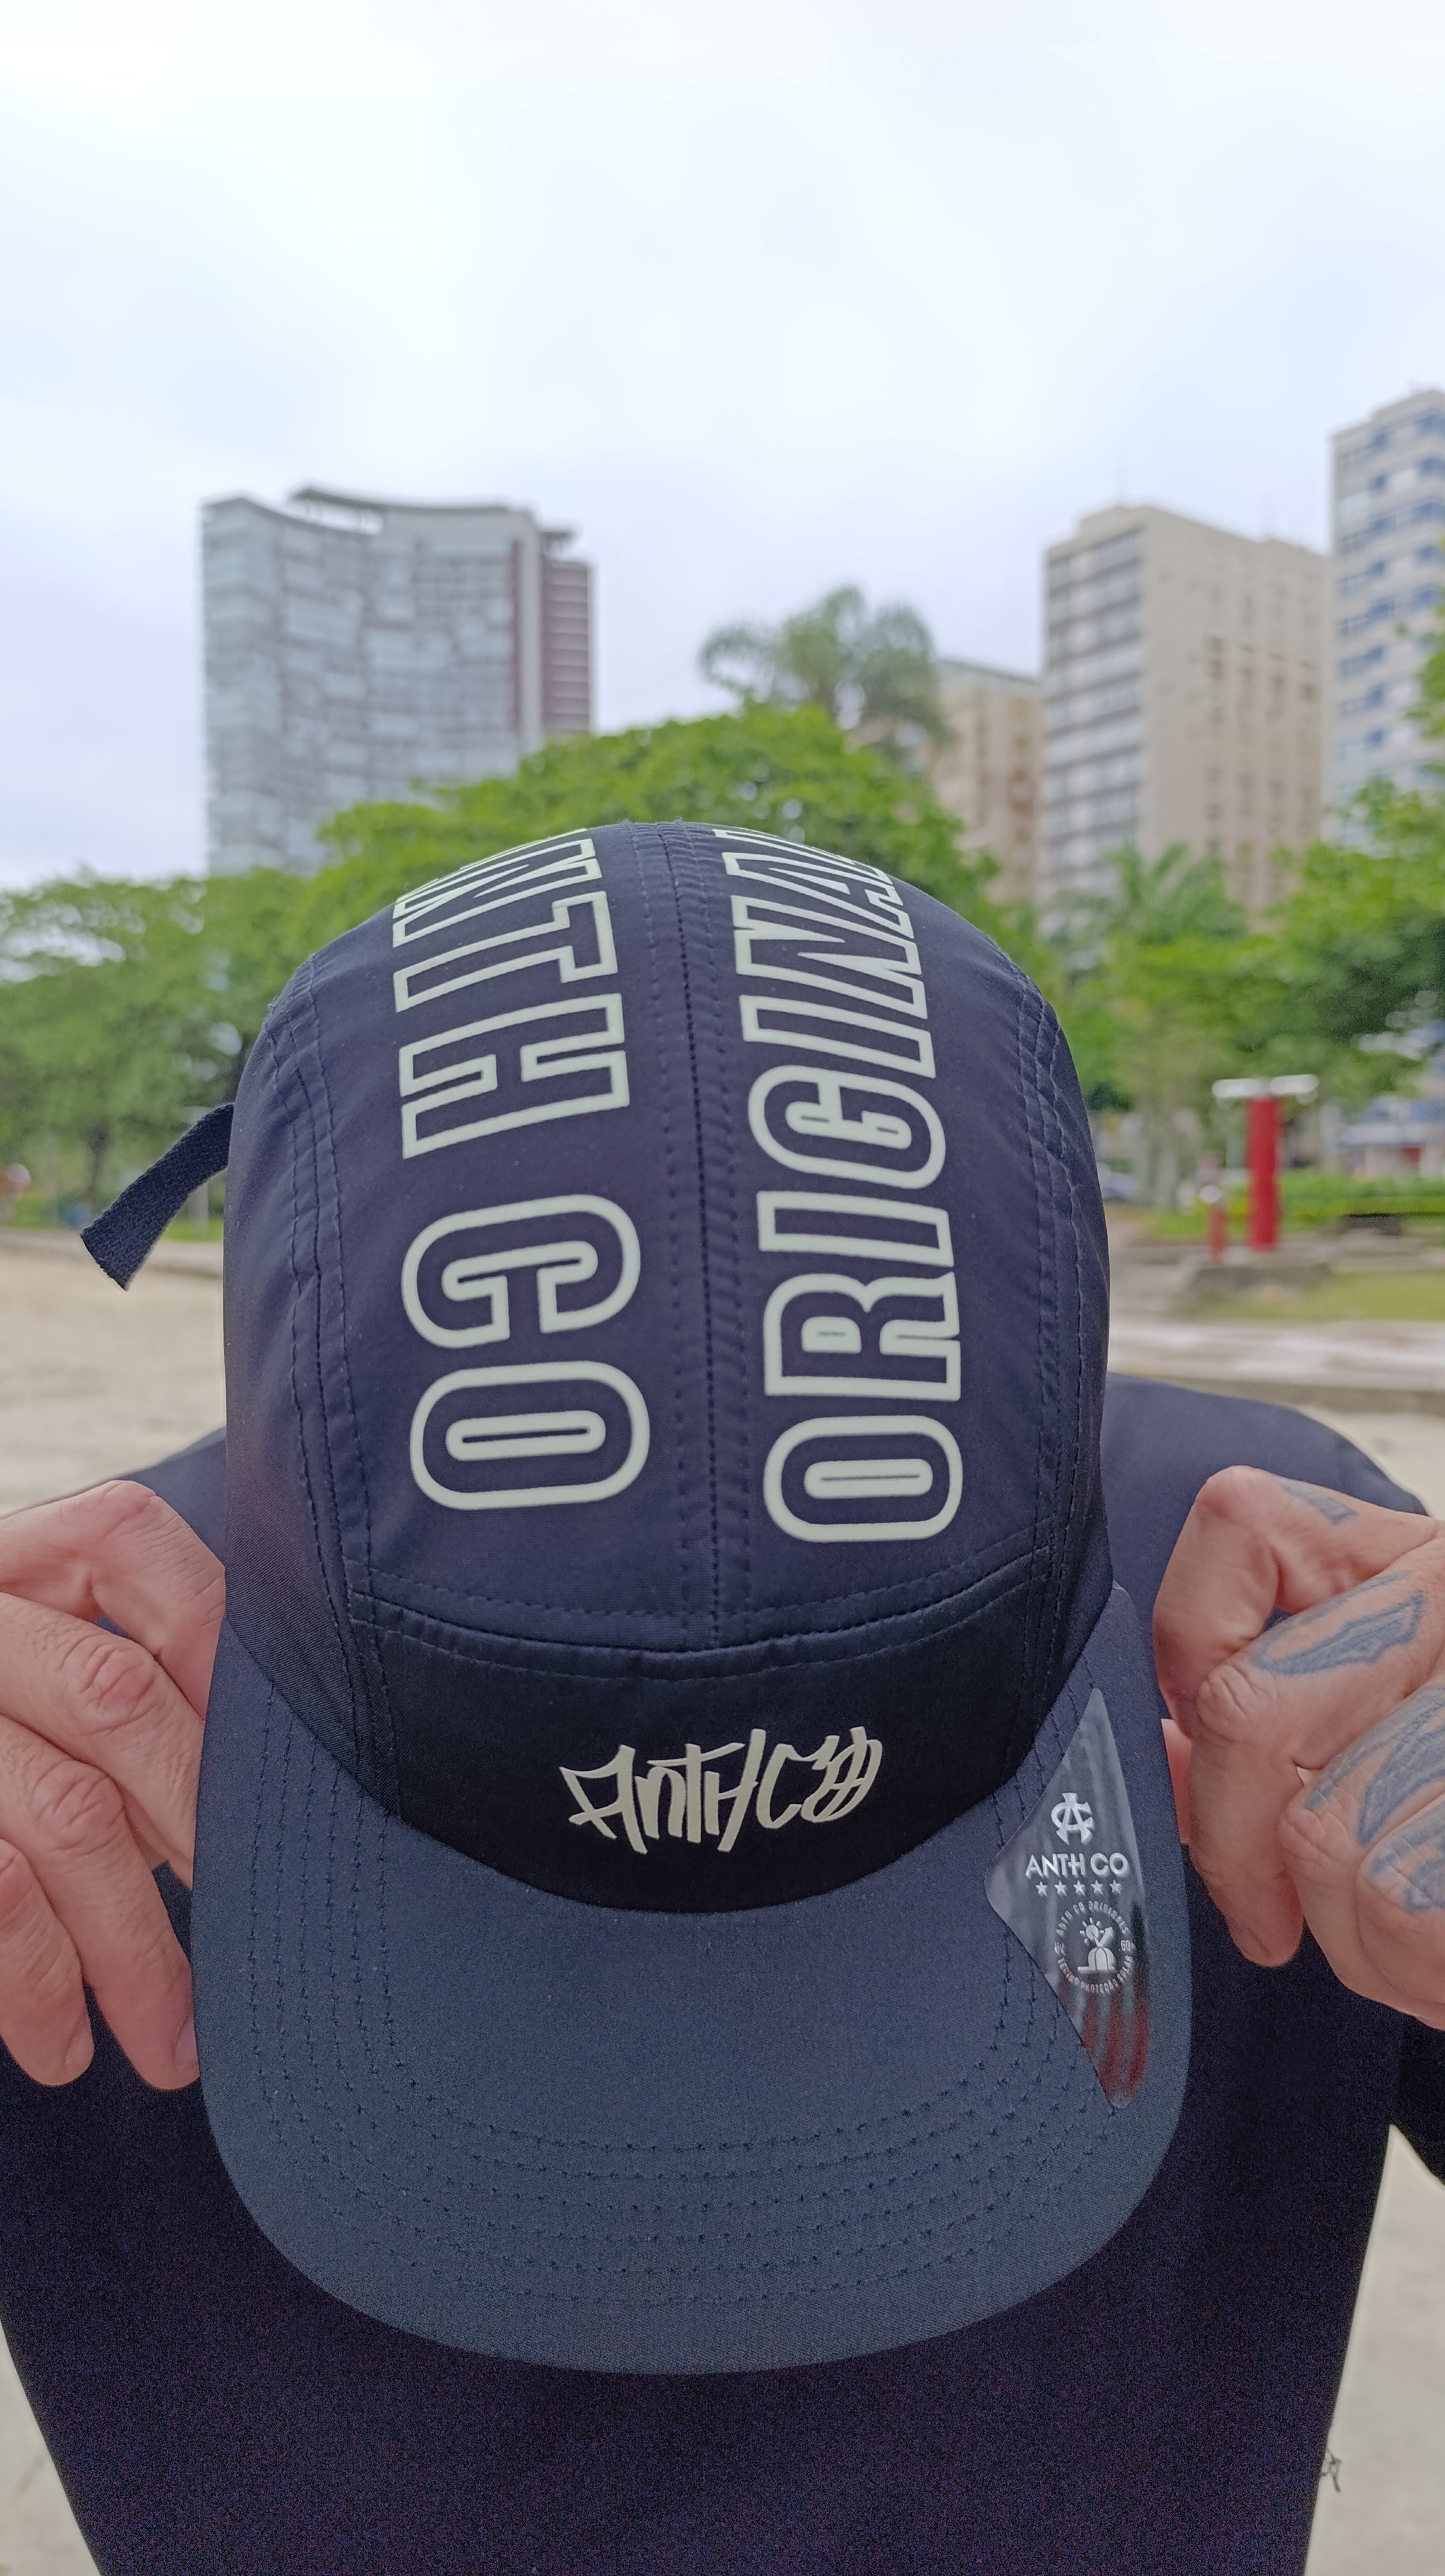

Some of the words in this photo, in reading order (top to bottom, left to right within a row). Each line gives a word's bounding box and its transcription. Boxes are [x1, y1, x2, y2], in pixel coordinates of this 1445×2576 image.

[392, 828, 630, 1159] NTH
[712, 826, 963, 1543] ORIGINAL
[402, 1194, 651, 1510] CO
[1025, 1853, 1086, 1878] ANTH
[1090, 1852, 1129, 1878] CO
[1074, 1902, 1084, 1914] CO
